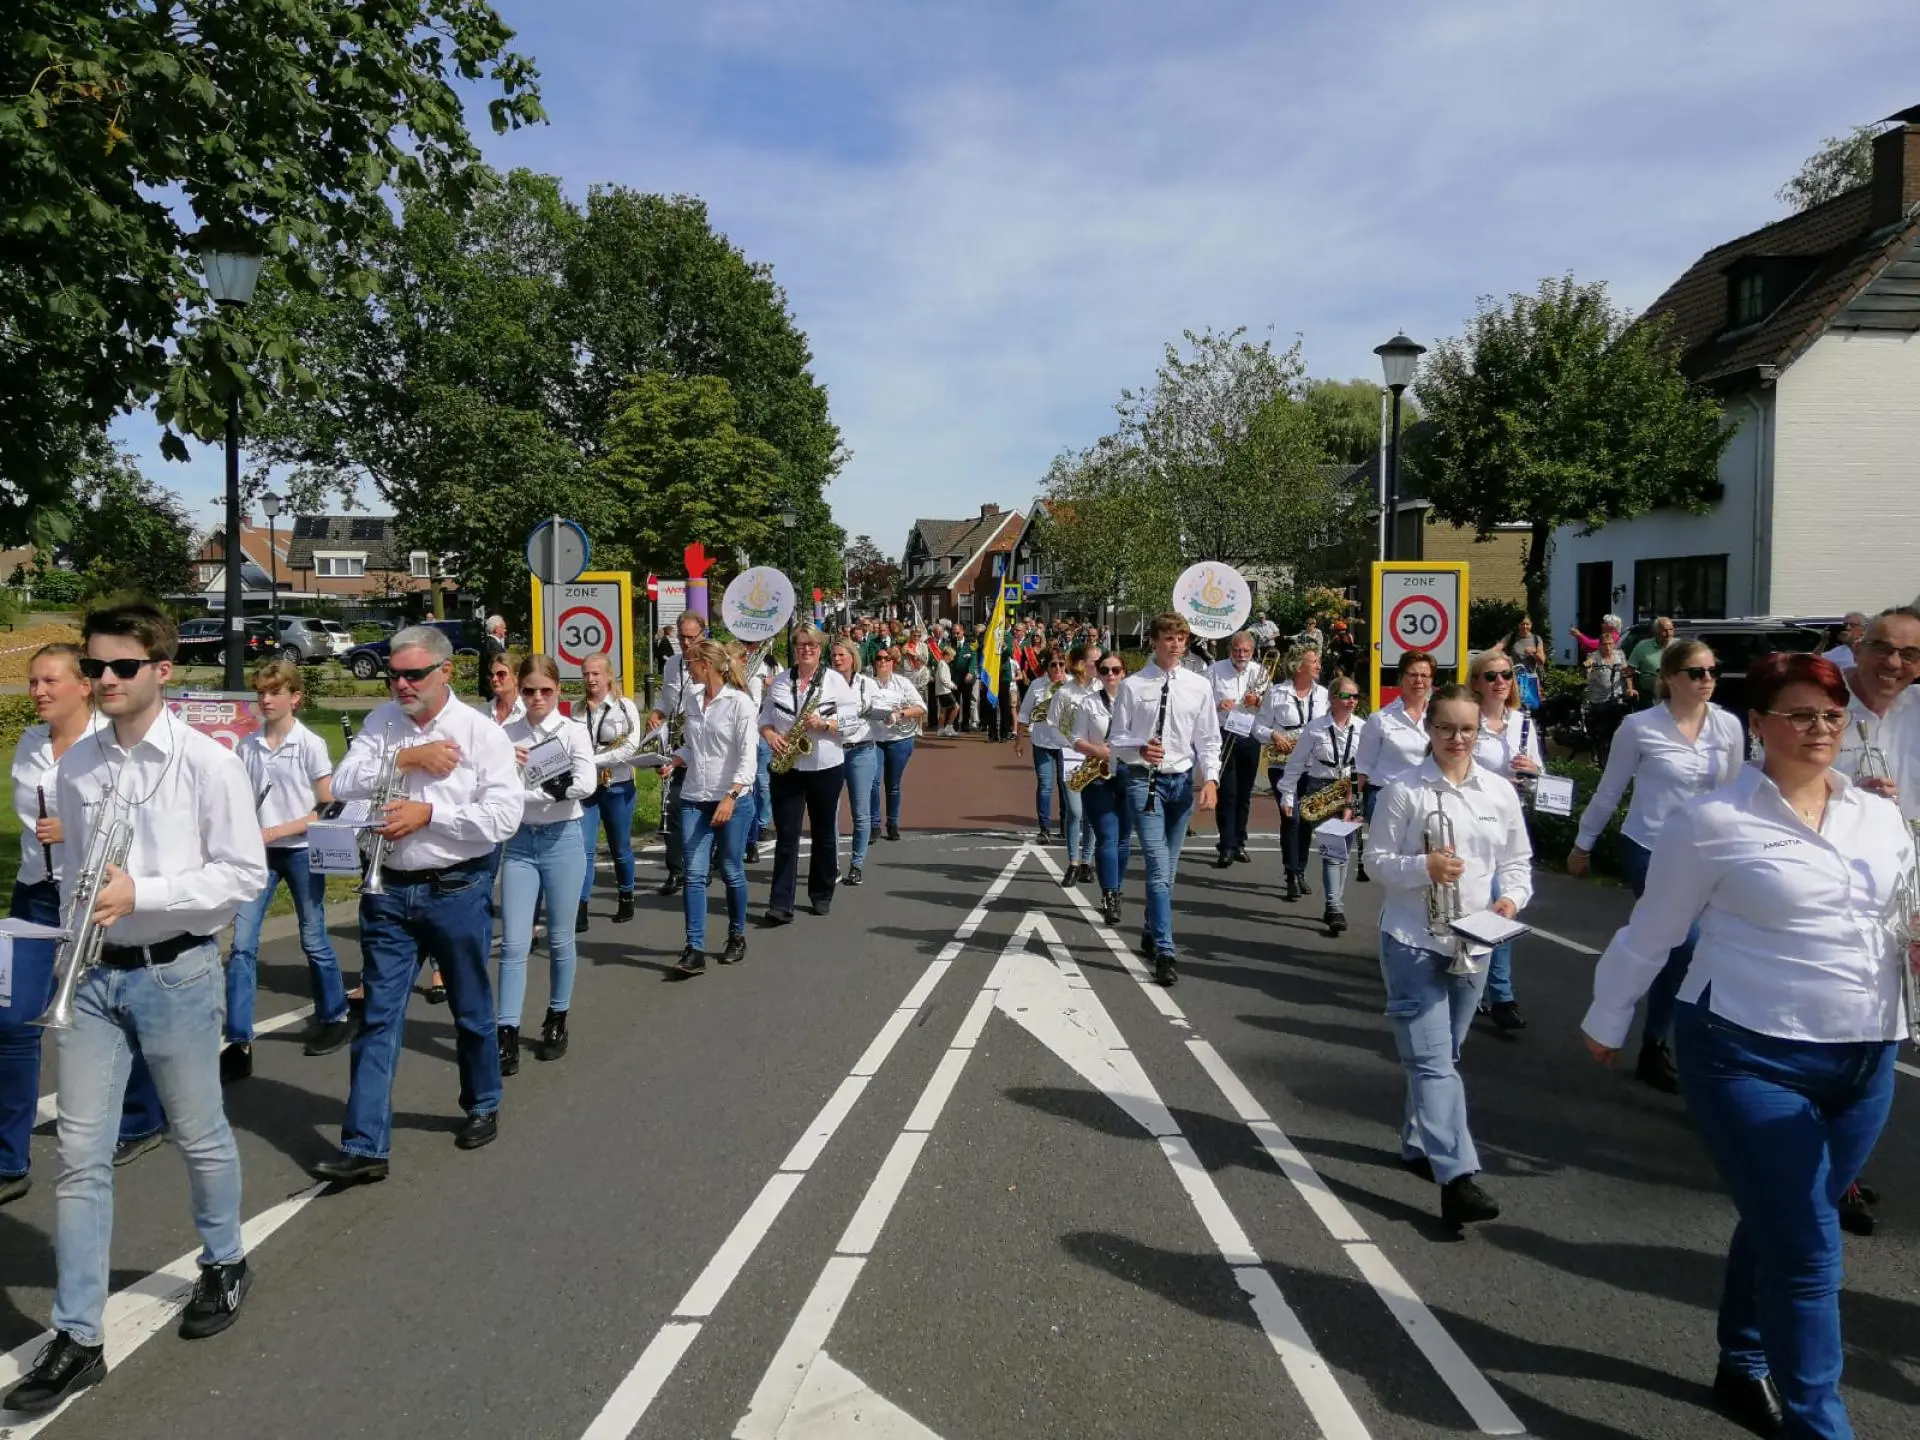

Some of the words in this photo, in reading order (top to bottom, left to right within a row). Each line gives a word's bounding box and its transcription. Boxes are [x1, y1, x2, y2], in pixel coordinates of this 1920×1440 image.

[1403, 577, 1436, 586] ZONE
[565, 588, 598, 597] ZONE
[732, 620, 774, 632] AMICITIA
[1189, 617, 1233, 631] AMICITIA
[1402, 614, 1437, 635] 30
[565, 626, 601, 647] 30
[1763, 839, 1802, 850] AMICITIA
